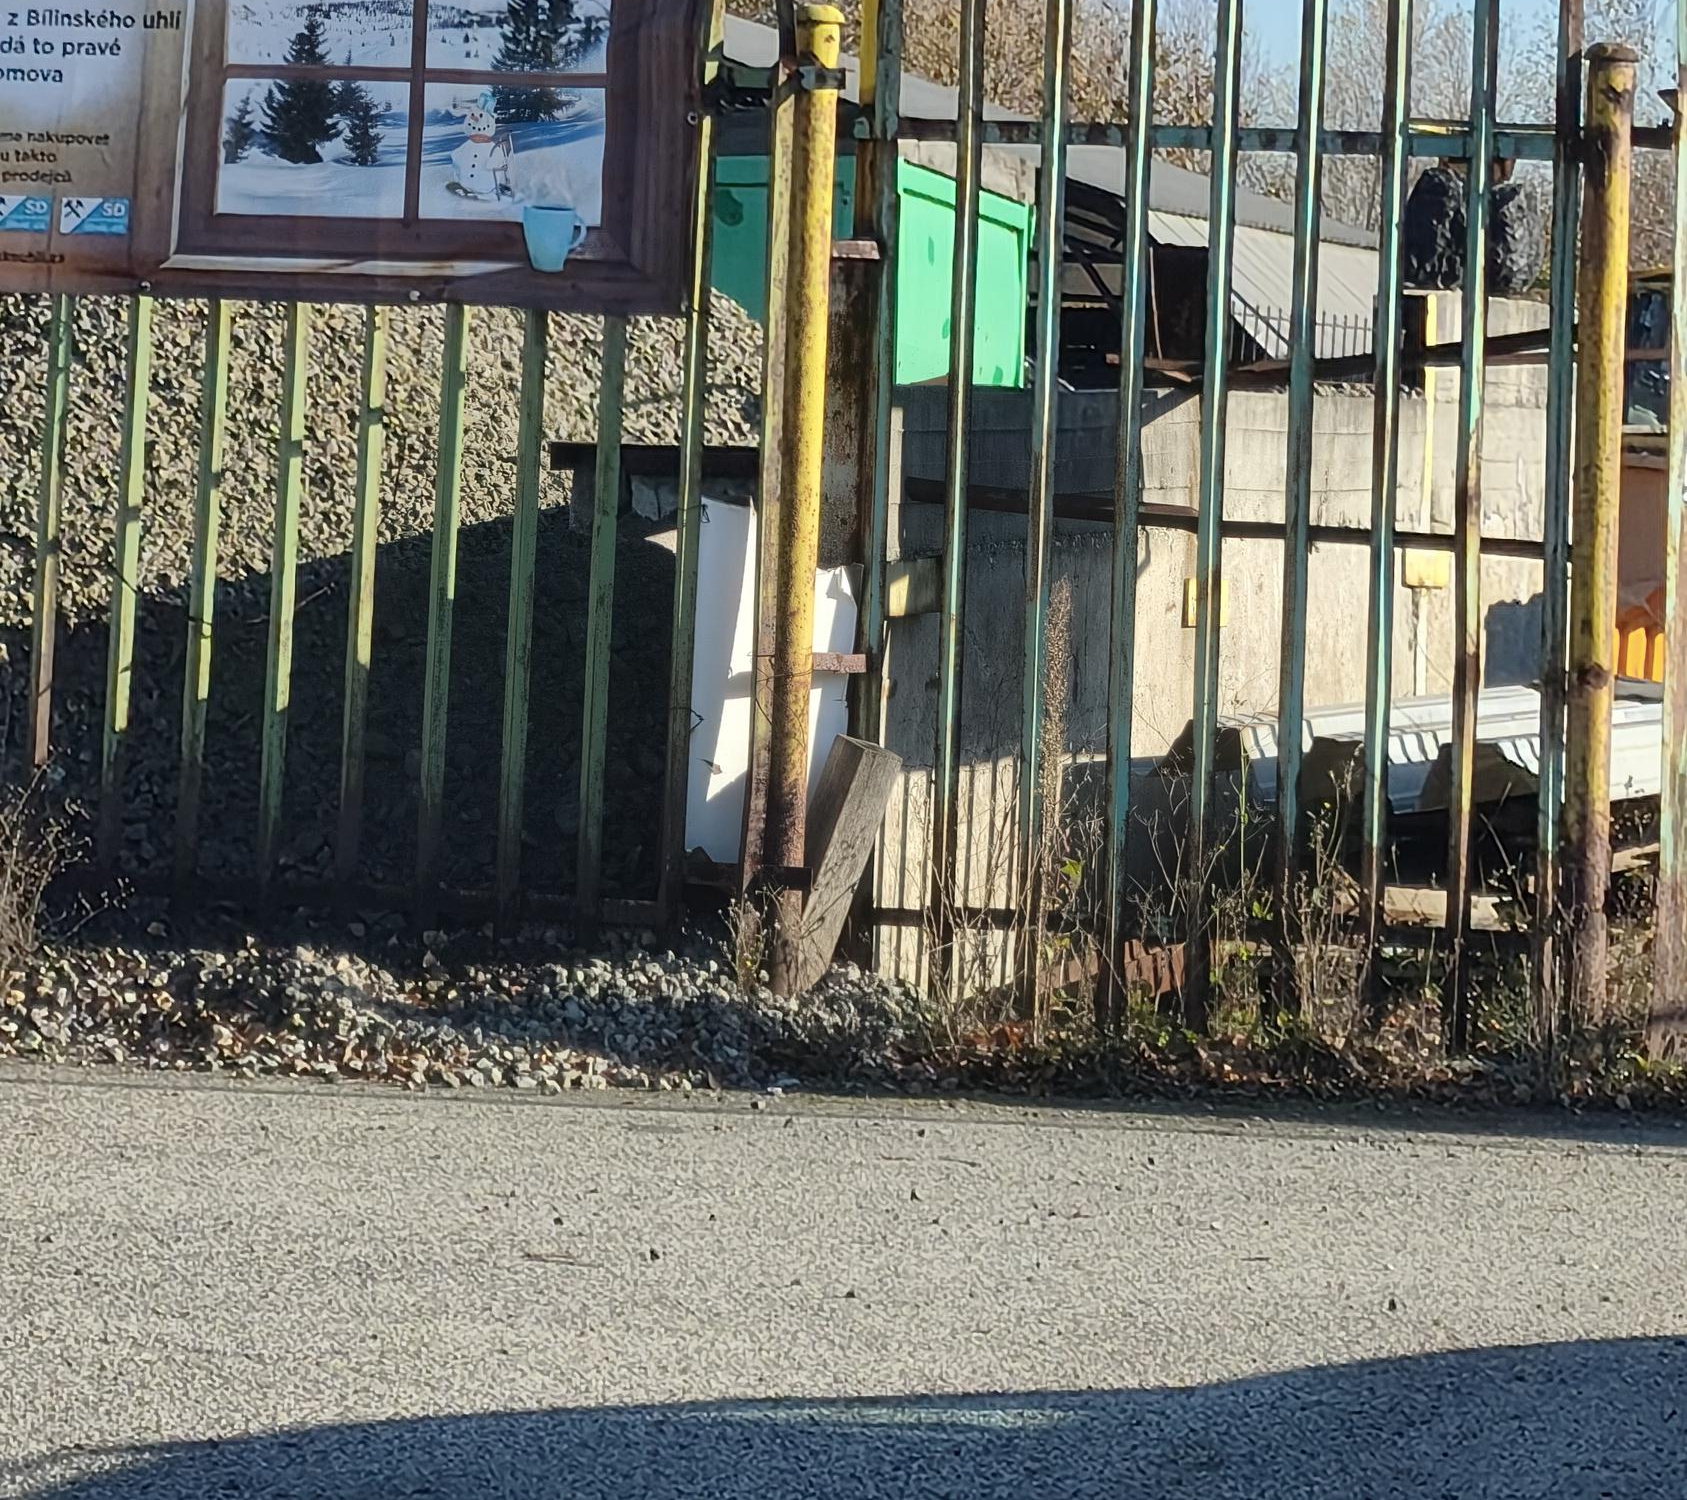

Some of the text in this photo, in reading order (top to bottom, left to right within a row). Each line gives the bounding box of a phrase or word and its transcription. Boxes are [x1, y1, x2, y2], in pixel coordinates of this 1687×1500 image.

[7, 12, 19, 27] z
[34, 38, 55, 54] to
[62, 37, 122, 58] pravé
[102, 202, 126, 217] SD
